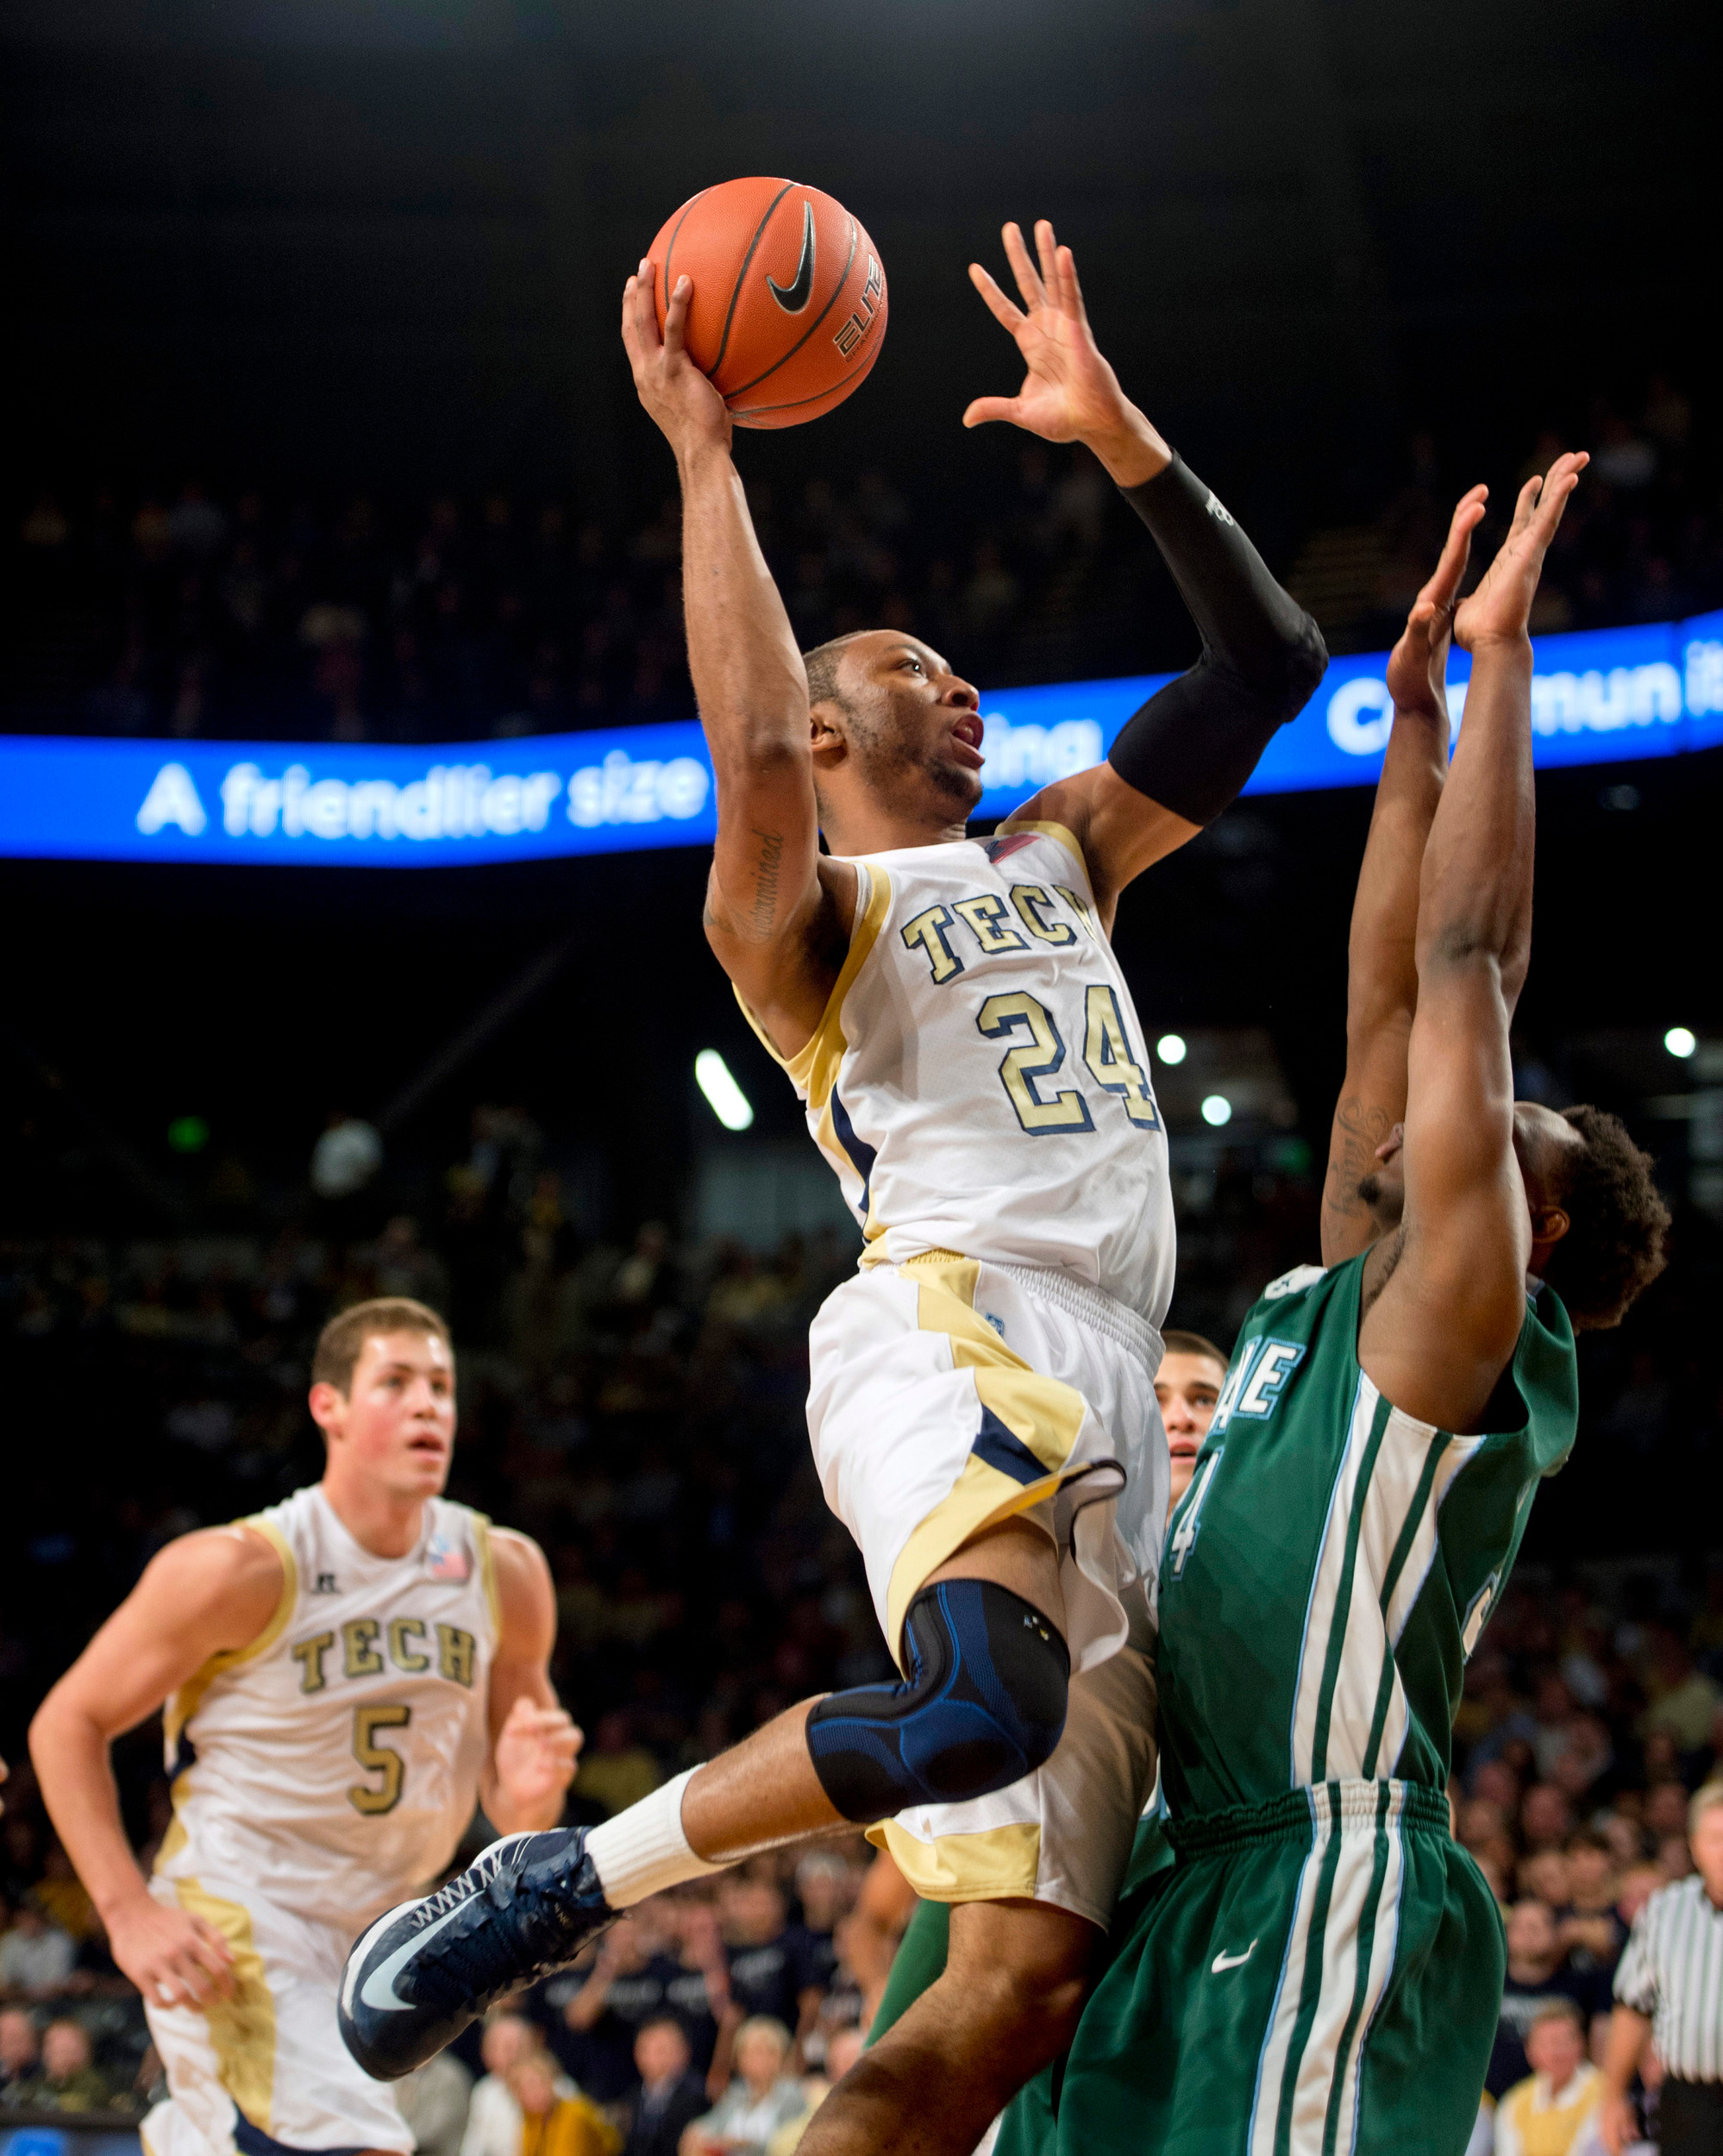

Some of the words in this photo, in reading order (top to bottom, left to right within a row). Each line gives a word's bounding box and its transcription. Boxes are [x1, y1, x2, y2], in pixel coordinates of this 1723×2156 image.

[832, 254, 883, 357] ELITE
[135, 762, 208, 836] A
[219, 761, 561, 838] friendlier
[567, 749, 710, 829] size
[980, 712, 1104, 790] ing
[975, 985, 1162, 1136] 24
[291, 1618, 476, 1695] TECH
[347, 1705, 411, 1816] 5
